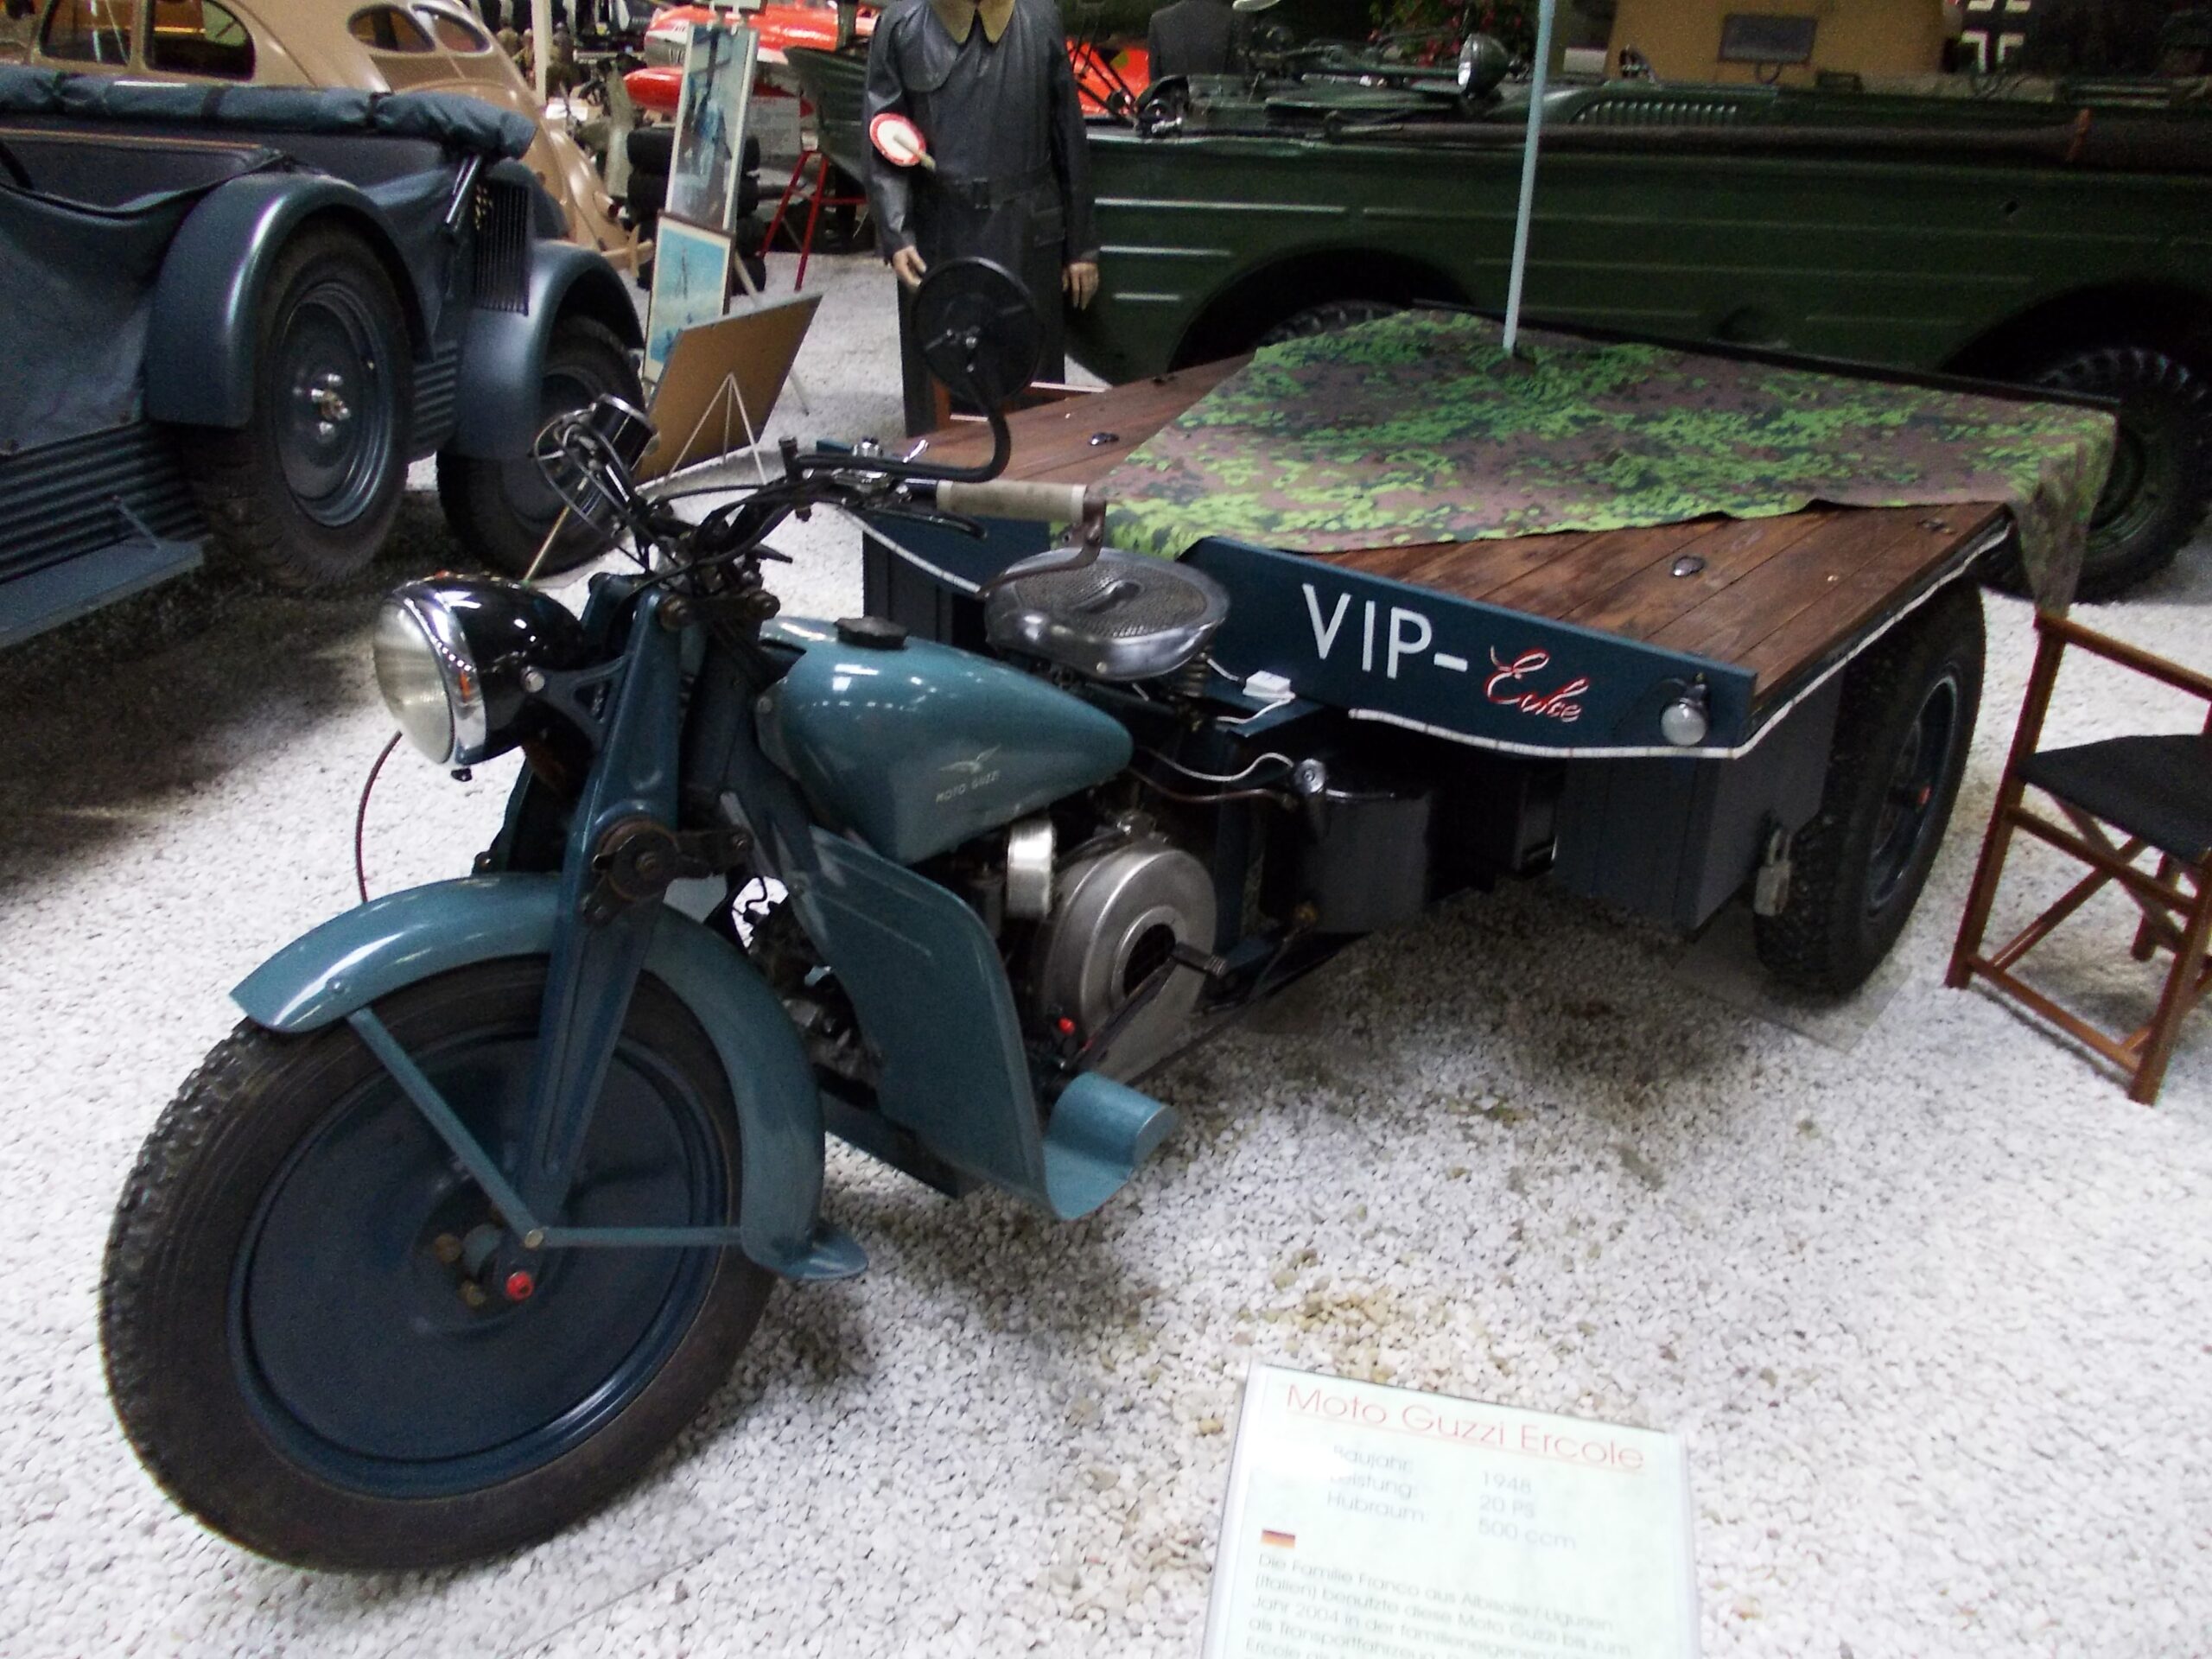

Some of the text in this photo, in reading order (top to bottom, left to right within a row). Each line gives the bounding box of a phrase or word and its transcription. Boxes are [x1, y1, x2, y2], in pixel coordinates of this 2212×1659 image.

[1302, 583, 1468, 679] VIP-
[936, 783, 967, 802] MOTO
[1286, 1383, 1644, 1470] Moto Guzzi Ercole
[1482, 1470, 1532, 1495] 1948
[1326, 1490, 1430, 1523] Hubraum:
[1478, 1494, 1535, 1519] 20 PS
[1478, 1517, 1577, 1550] 500 ccm
[1258, 1553, 1287, 1570] Die
[1292, 1559, 1353, 1583] Familie
[1358, 1573, 1420, 1597] Franco
[1248, 1617, 1273, 1633] als
[1252, 1595, 1289, 1613] Jahr
[1294, 1604, 1338, 1623] 2004
[1344, 1613, 1360, 1629] in
[1458, 1612, 1504, 1634] Moto
[1510, 1621, 1557, 1643] Guzzi
